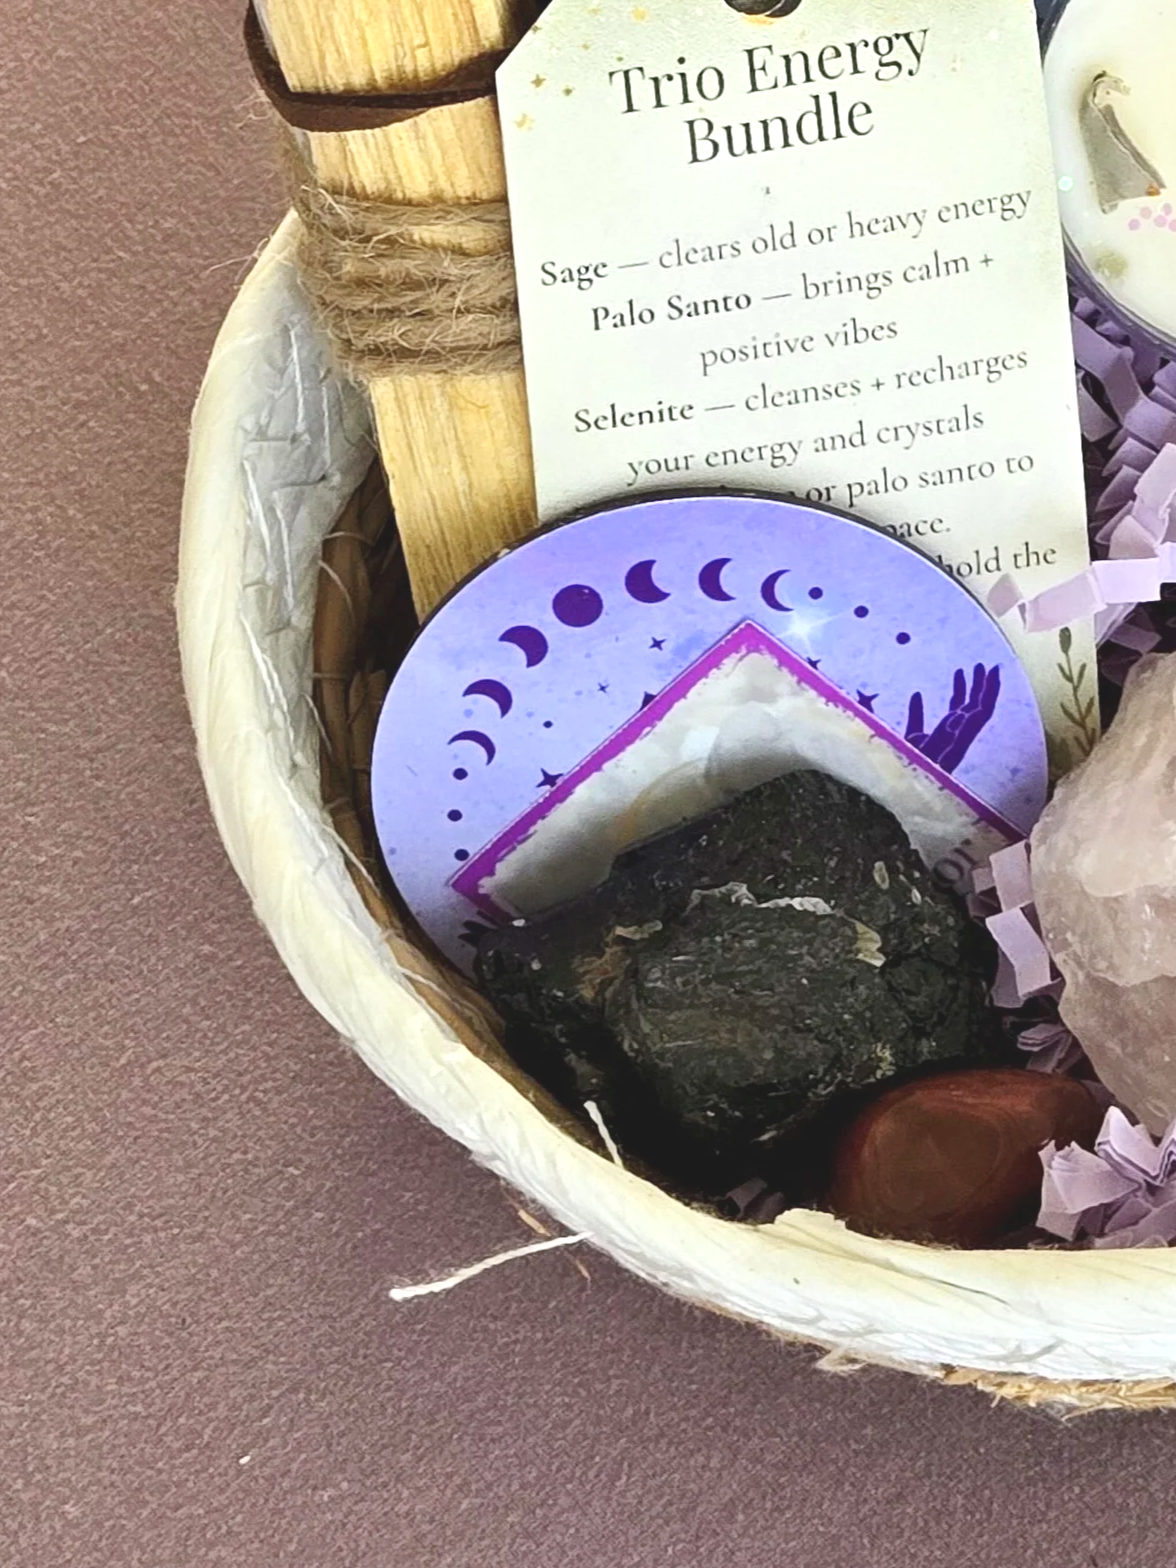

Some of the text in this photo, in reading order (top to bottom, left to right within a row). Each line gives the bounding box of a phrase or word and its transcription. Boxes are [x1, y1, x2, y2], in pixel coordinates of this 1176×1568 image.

[608, 28, 929, 114] Trio Energy
[684, 90, 875, 164] Bundle
[540, 260, 609, 291] Sage
[659, 237, 742, 269] clears
[751, 220, 798, 255] old
[807, 224, 838, 246] or
[846, 209, 928, 239] heavy
[937, 189, 1032, 223] energy
[591, 298, 655, 331] Palo
[666, 292, 752, 321] Santo
[801, 269, 894, 300] brings
[902, 249, 970, 284] calm
[700, 317, 898, 377] positive vibes
[574, 400, 694, 433] Selenite
[745, 378, 862, 412] cleanses
[893, 350, 1028, 390] recharges
[627, 403, 985, 487] your energy and crystals
[805, 484, 838, 503] or
[846, 466, 909, 509] palo
[918, 460, 995, 489] santo
[1005, 454, 1034, 475] to
[886, 516, 951, 539] ace.
[1012, 541, 1057, 570] the
